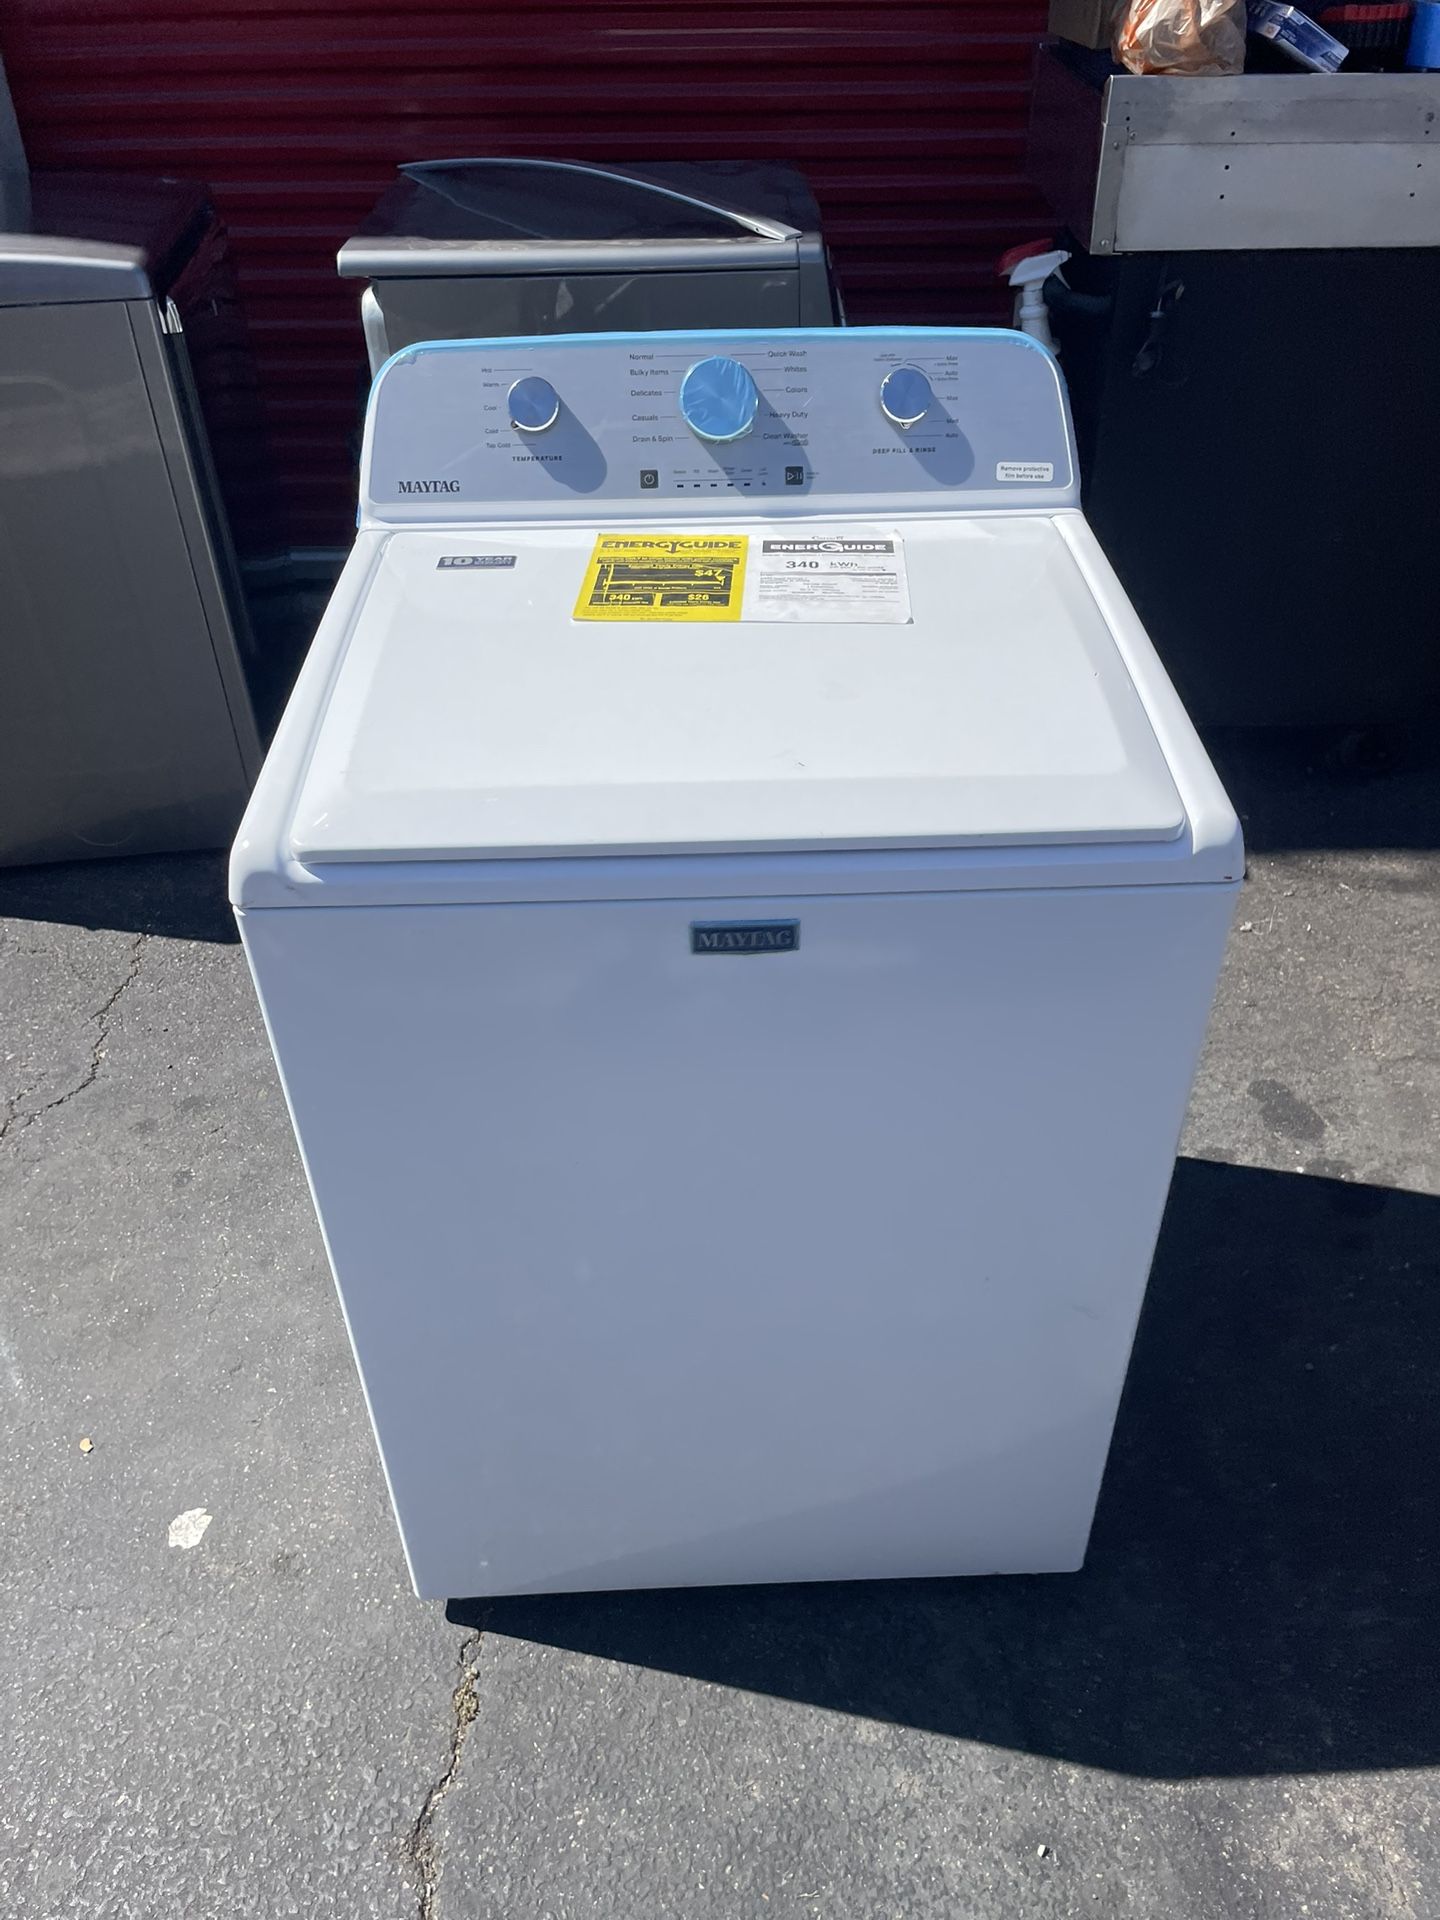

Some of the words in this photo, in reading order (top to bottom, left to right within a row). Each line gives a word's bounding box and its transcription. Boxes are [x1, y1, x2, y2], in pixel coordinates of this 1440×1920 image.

[629, 353, 654, 361] Normal
[767, 350, 787, 358] Quick
[788, 350, 808, 358] Wash
[629, 369, 649, 377] Bulky
[630, 389, 663, 397] Delicates
[631, 414, 659, 422] Casuals
[768, 411, 791, 419] Heavy
[791, 411, 809, 419] Duty
[632, 435, 651, 443] Drain
[657, 434, 674, 443] Spin
[762, 432, 781, 440] Clean
[783, 432, 809, 440] Washer
[398, 480, 460, 494] MAYTAG
[600, 540, 742, 552] ENERGYGUIDE
[442, 557, 474, 566] 10
[785, 560, 820, 569] 340
[829, 560, 859, 568] kWh
[694, 569, 723, 578] $47
[687, 593, 710, 601] $26
[698, 930, 793, 948] MAYTAG
